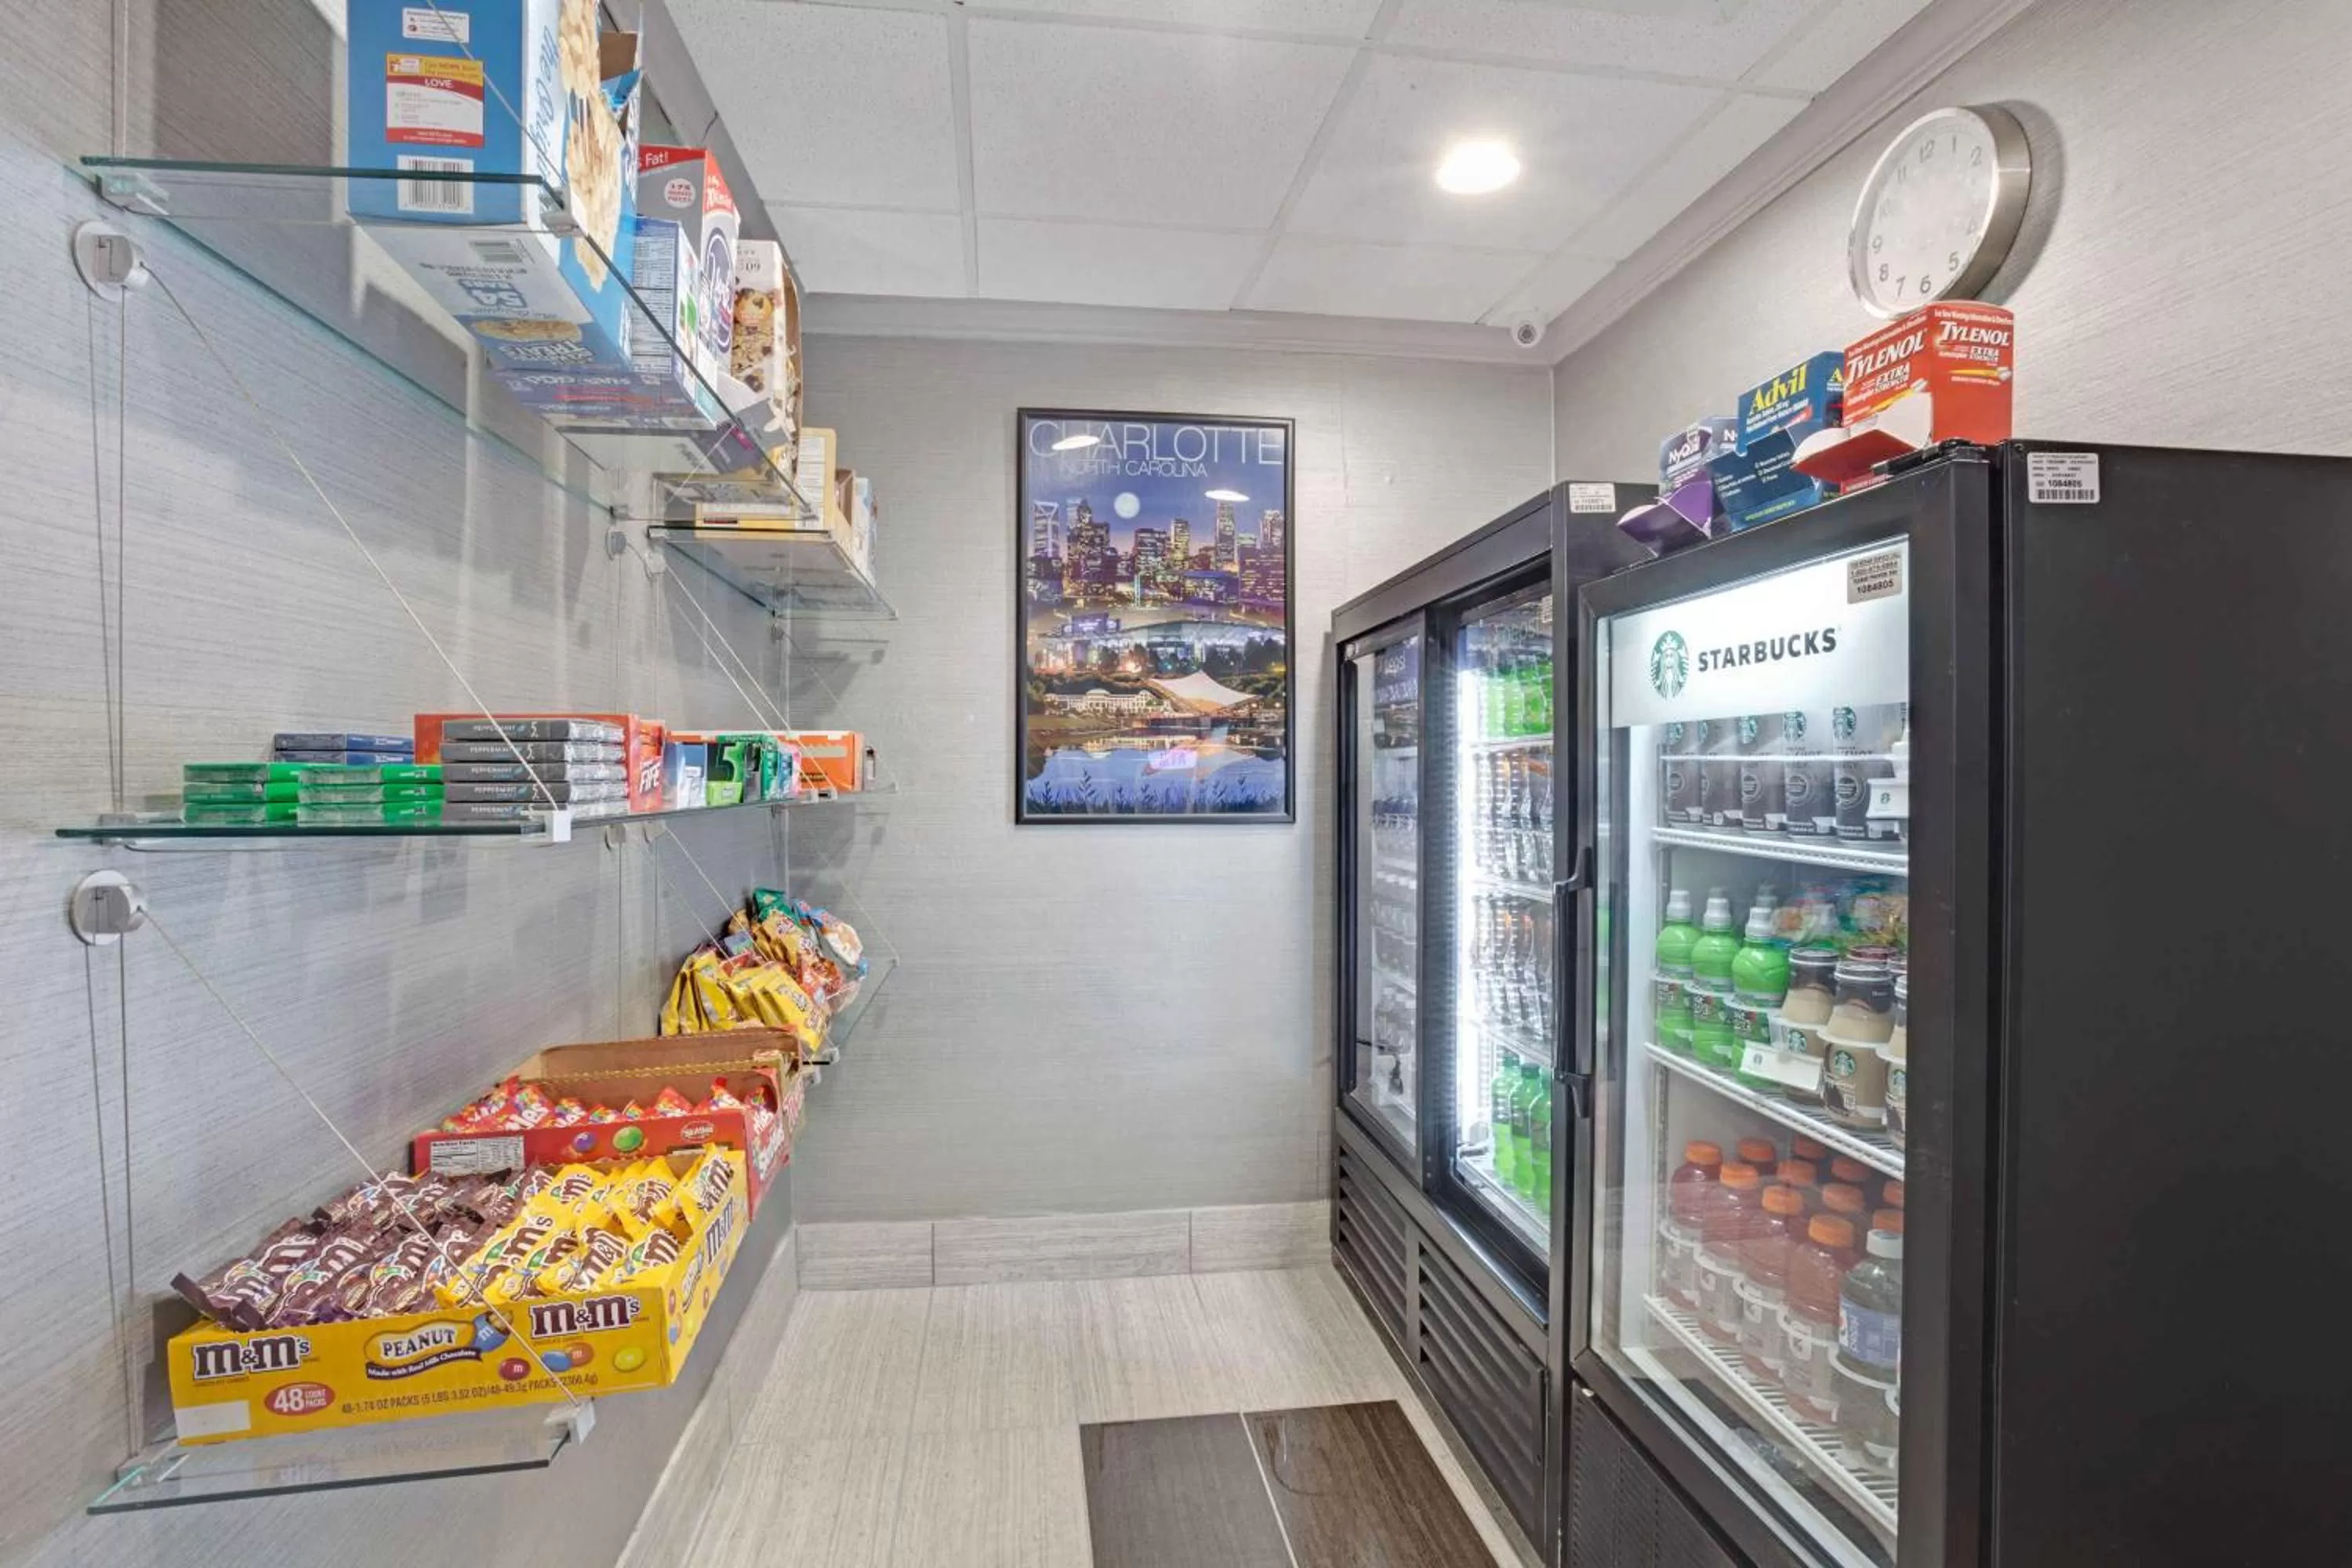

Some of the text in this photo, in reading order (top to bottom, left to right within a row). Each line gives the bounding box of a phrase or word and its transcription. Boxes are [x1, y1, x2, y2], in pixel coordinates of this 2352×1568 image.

[424, 78, 452, 88] LOVE
[1918, 139, 1935, 163] 12
[1951, 134, 1958, 153] 1
[645, 150, 669, 168] Fat!
[1970, 145, 1983, 167] 2
[1896, 164, 1907, 184] 11
[1871, 235, 1882, 255] 9
[1878, 263, 1889, 283] 8
[1947, 251, 1960, 274] 5
[1894, 275, 1906, 300] 7
[1919, 275, 1932, 294] 6
[1939, 321, 2010, 347] TYLENOL
[1844, 330, 1925, 389] TYLENOL
[1749, 363, 1807, 415] Advil
[1029, 419, 1283, 465] CHARLOTTE
[1061, 459, 1208, 477] NORTH CAROLINA
[1697, 626, 1837, 673] STARBUCKS
[533, 1295, 640, 1337] m&m's
[382, 1328, 456, 1358] PEANUT
[194, 1334, 311, 1378] m&m's
[368, 1349, 477, 1377] Made with Real Milk Chocolate
[274, 1388, 304, 1412] 48
[376, 1399, 390, 1410] OZ
[390, 1396, 419, 1409] PACKS
[431, 1391, 450, 1403] LBS
[528, 1377, 557, 1391] PACKS
